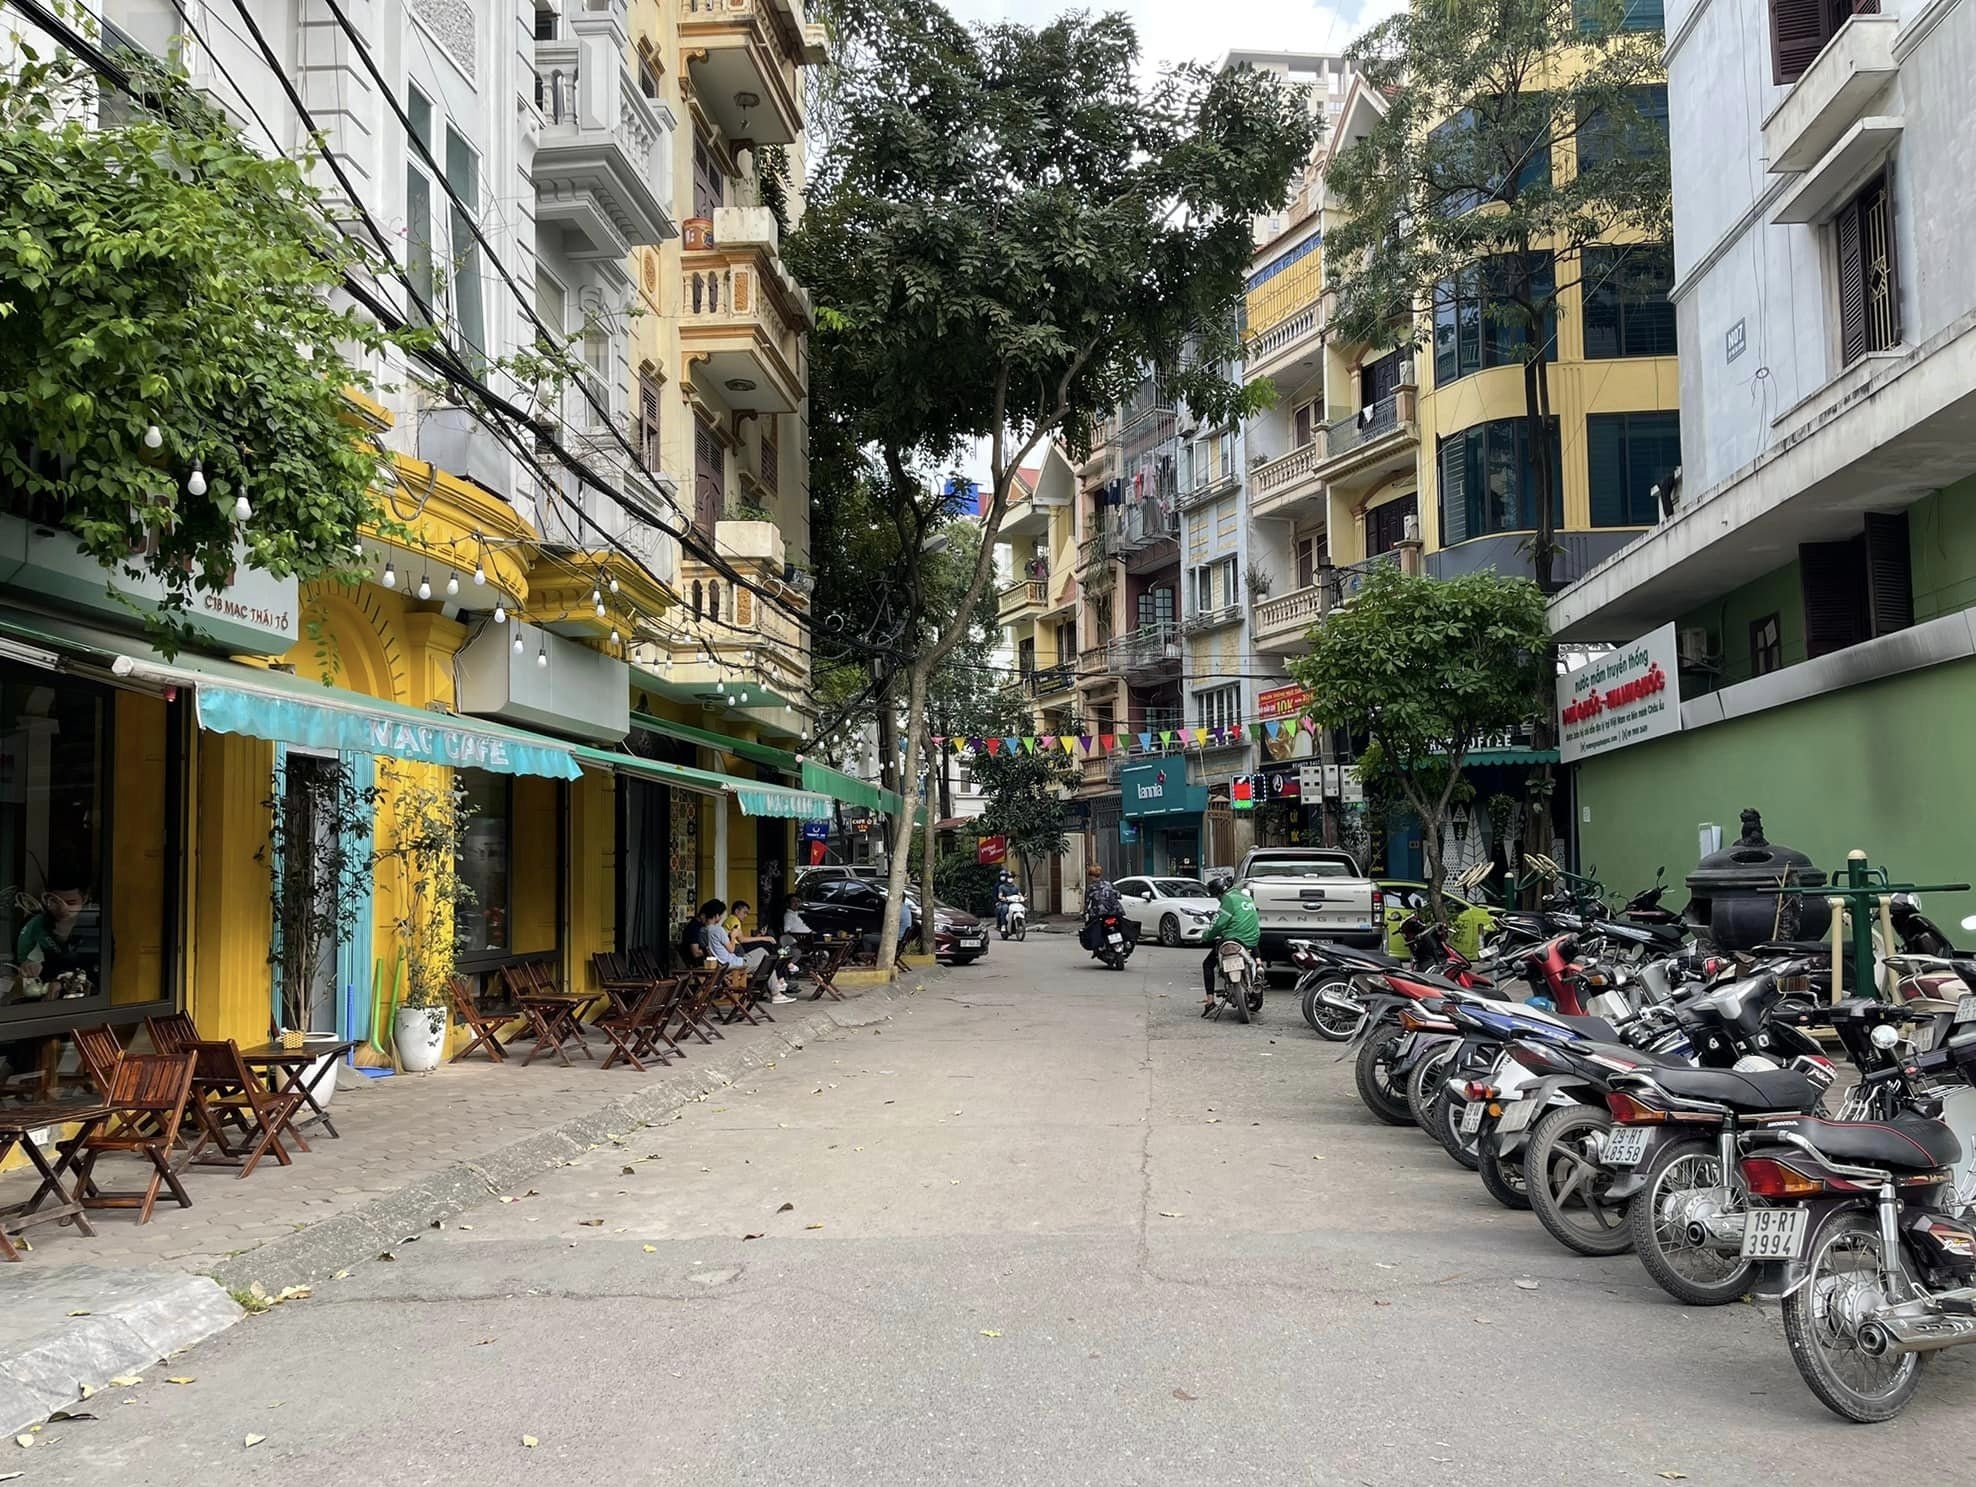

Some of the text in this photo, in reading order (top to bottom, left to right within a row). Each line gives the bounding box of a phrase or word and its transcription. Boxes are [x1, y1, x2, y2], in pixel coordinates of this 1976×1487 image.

[1612, 1129, 1643, 1144] 29-H1
[1755, 1212, 1796, 1232] 19-R1
[1749, 1234, 1791, 1255] 3994
